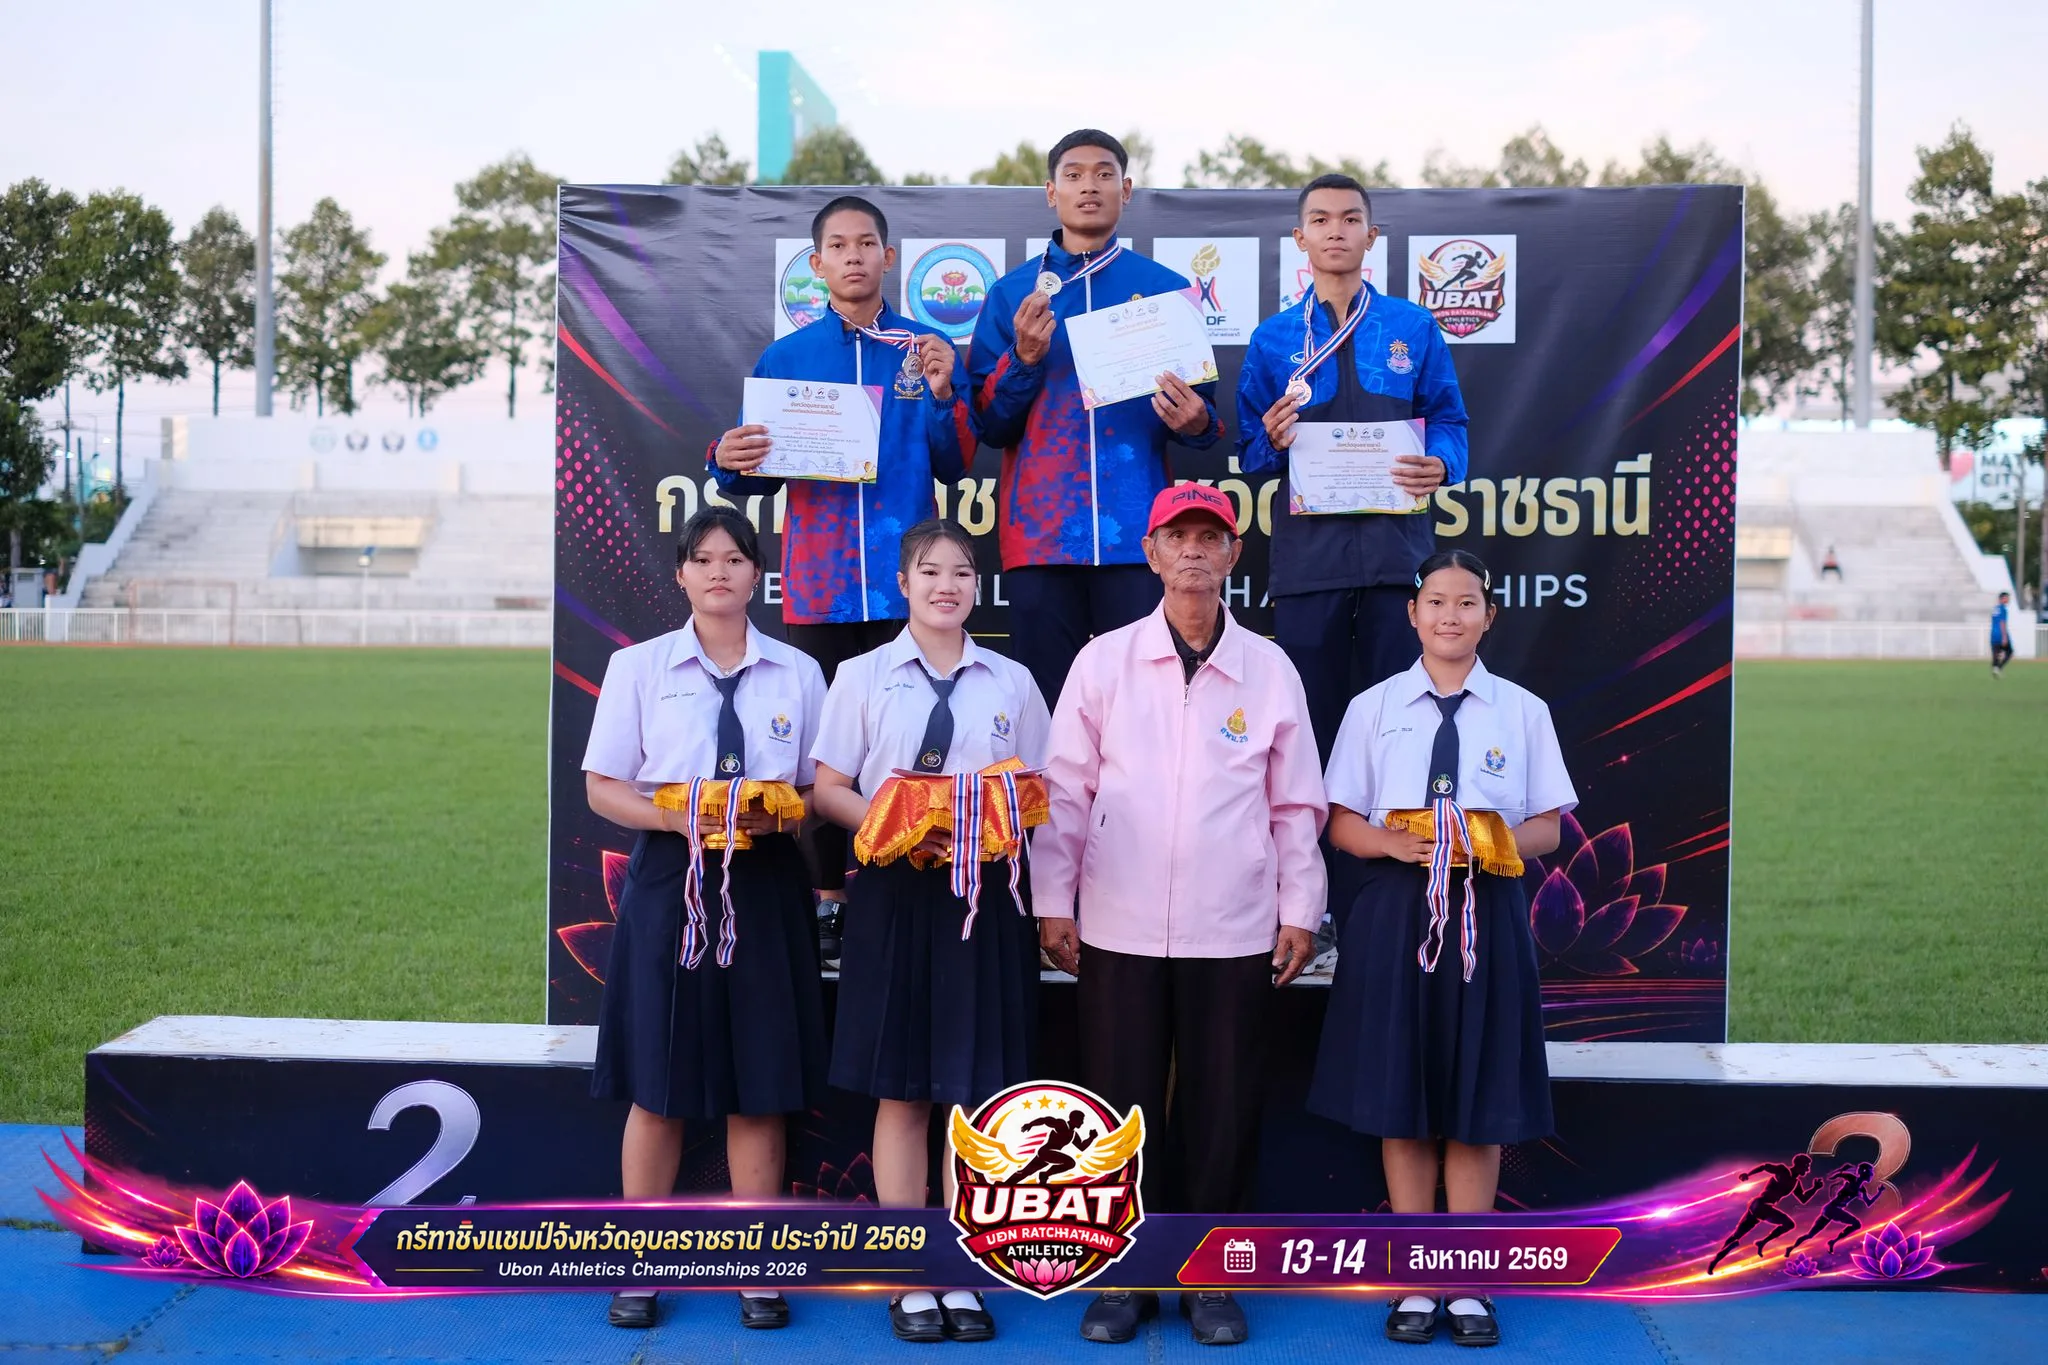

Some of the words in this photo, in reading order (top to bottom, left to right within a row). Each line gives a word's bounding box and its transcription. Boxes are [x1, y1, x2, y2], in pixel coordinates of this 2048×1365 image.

[1424, 290, 1500, 310] UBAT
[1206, 316, 1227, 326] DF
[1172, 489, 1224, 506] PING
[361, 1079, 481, 1207] 2
